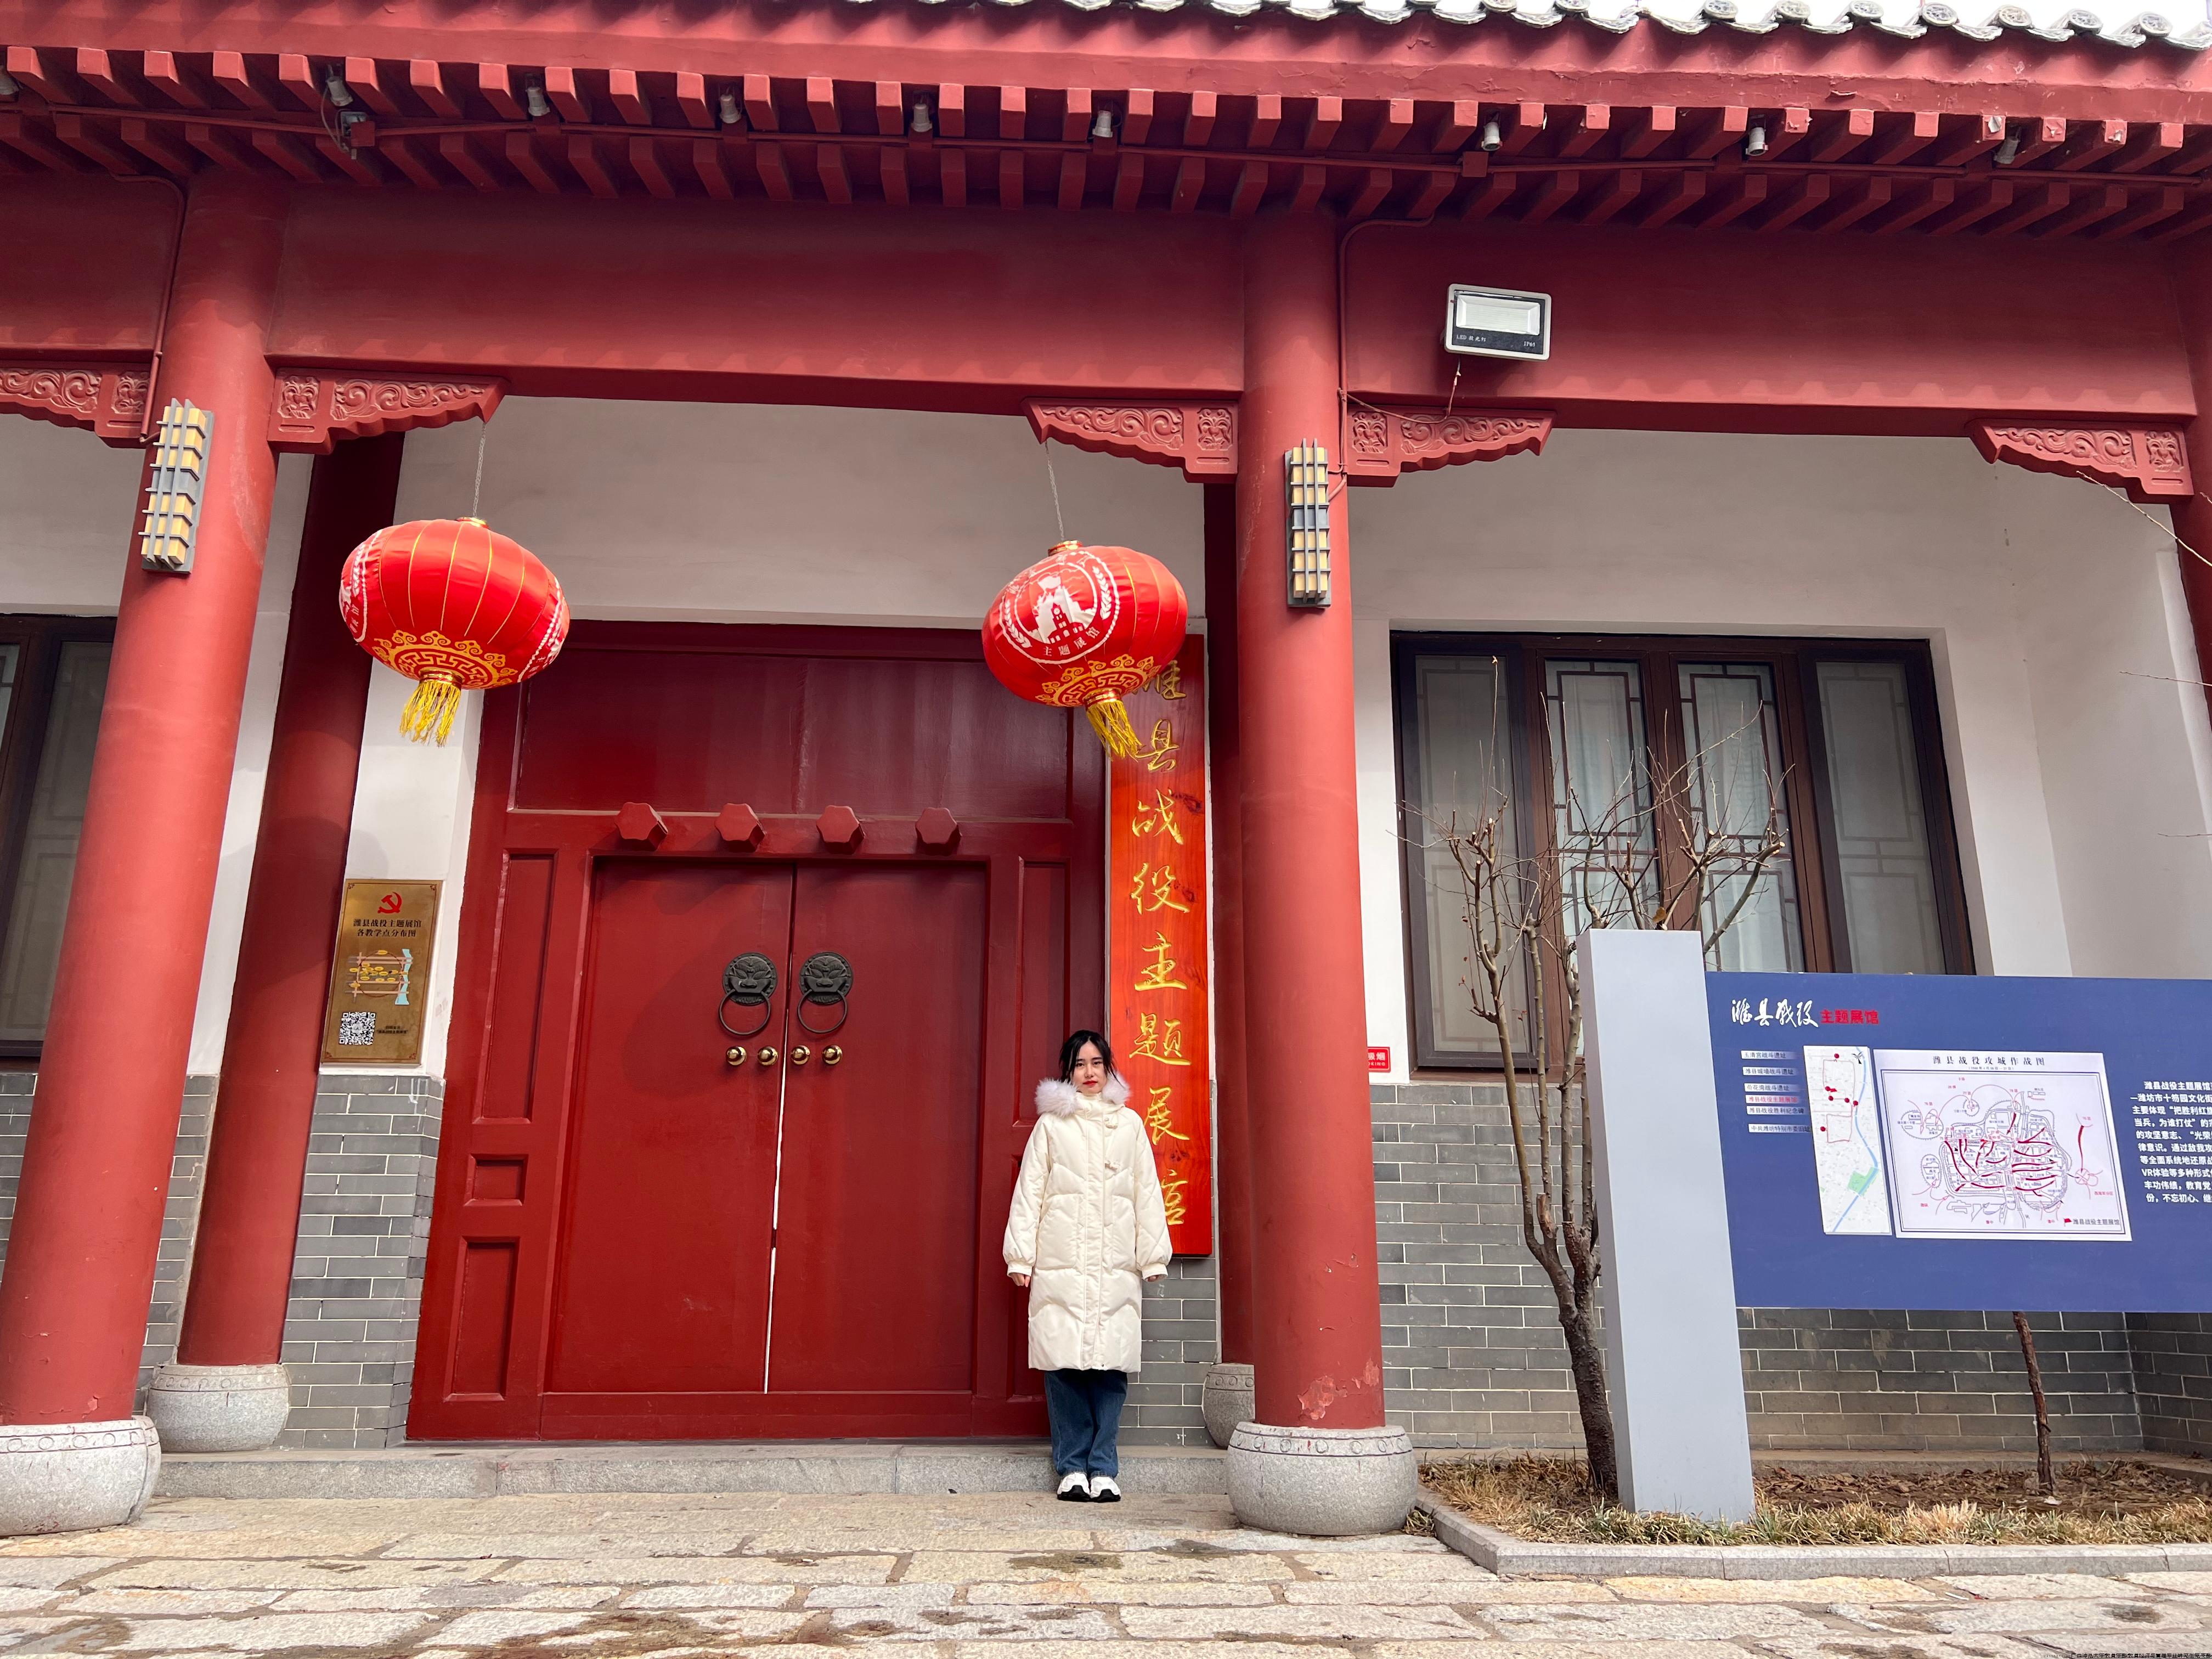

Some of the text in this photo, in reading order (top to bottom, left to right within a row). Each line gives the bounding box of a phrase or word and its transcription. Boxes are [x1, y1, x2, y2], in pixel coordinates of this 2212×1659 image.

[1043, 627, 1100, 657] 主题展馆
[353, 919, 422, 927] 潍县战役主题展馆
[357, 928, 416, 937] 各教学点分布图
[1731, 997, 1879, 1028] 潍县战役 主题展馆
[1933, 1055, 2045, 1066] 潍县战役攻城作战图
[2144, 1081, 2212, 1090] 潍县战役主题展馆
[2136, 1130, 2212, 1140] 的攻坚意志、“光荣
[2141, 1168, 2212, 1177] VR体验等多种形式
[2144, 1180, 2212, 1190] 丰功伟绩，教育党
[2146, 1193, 2212, 1203] 份，不忘初心、继
